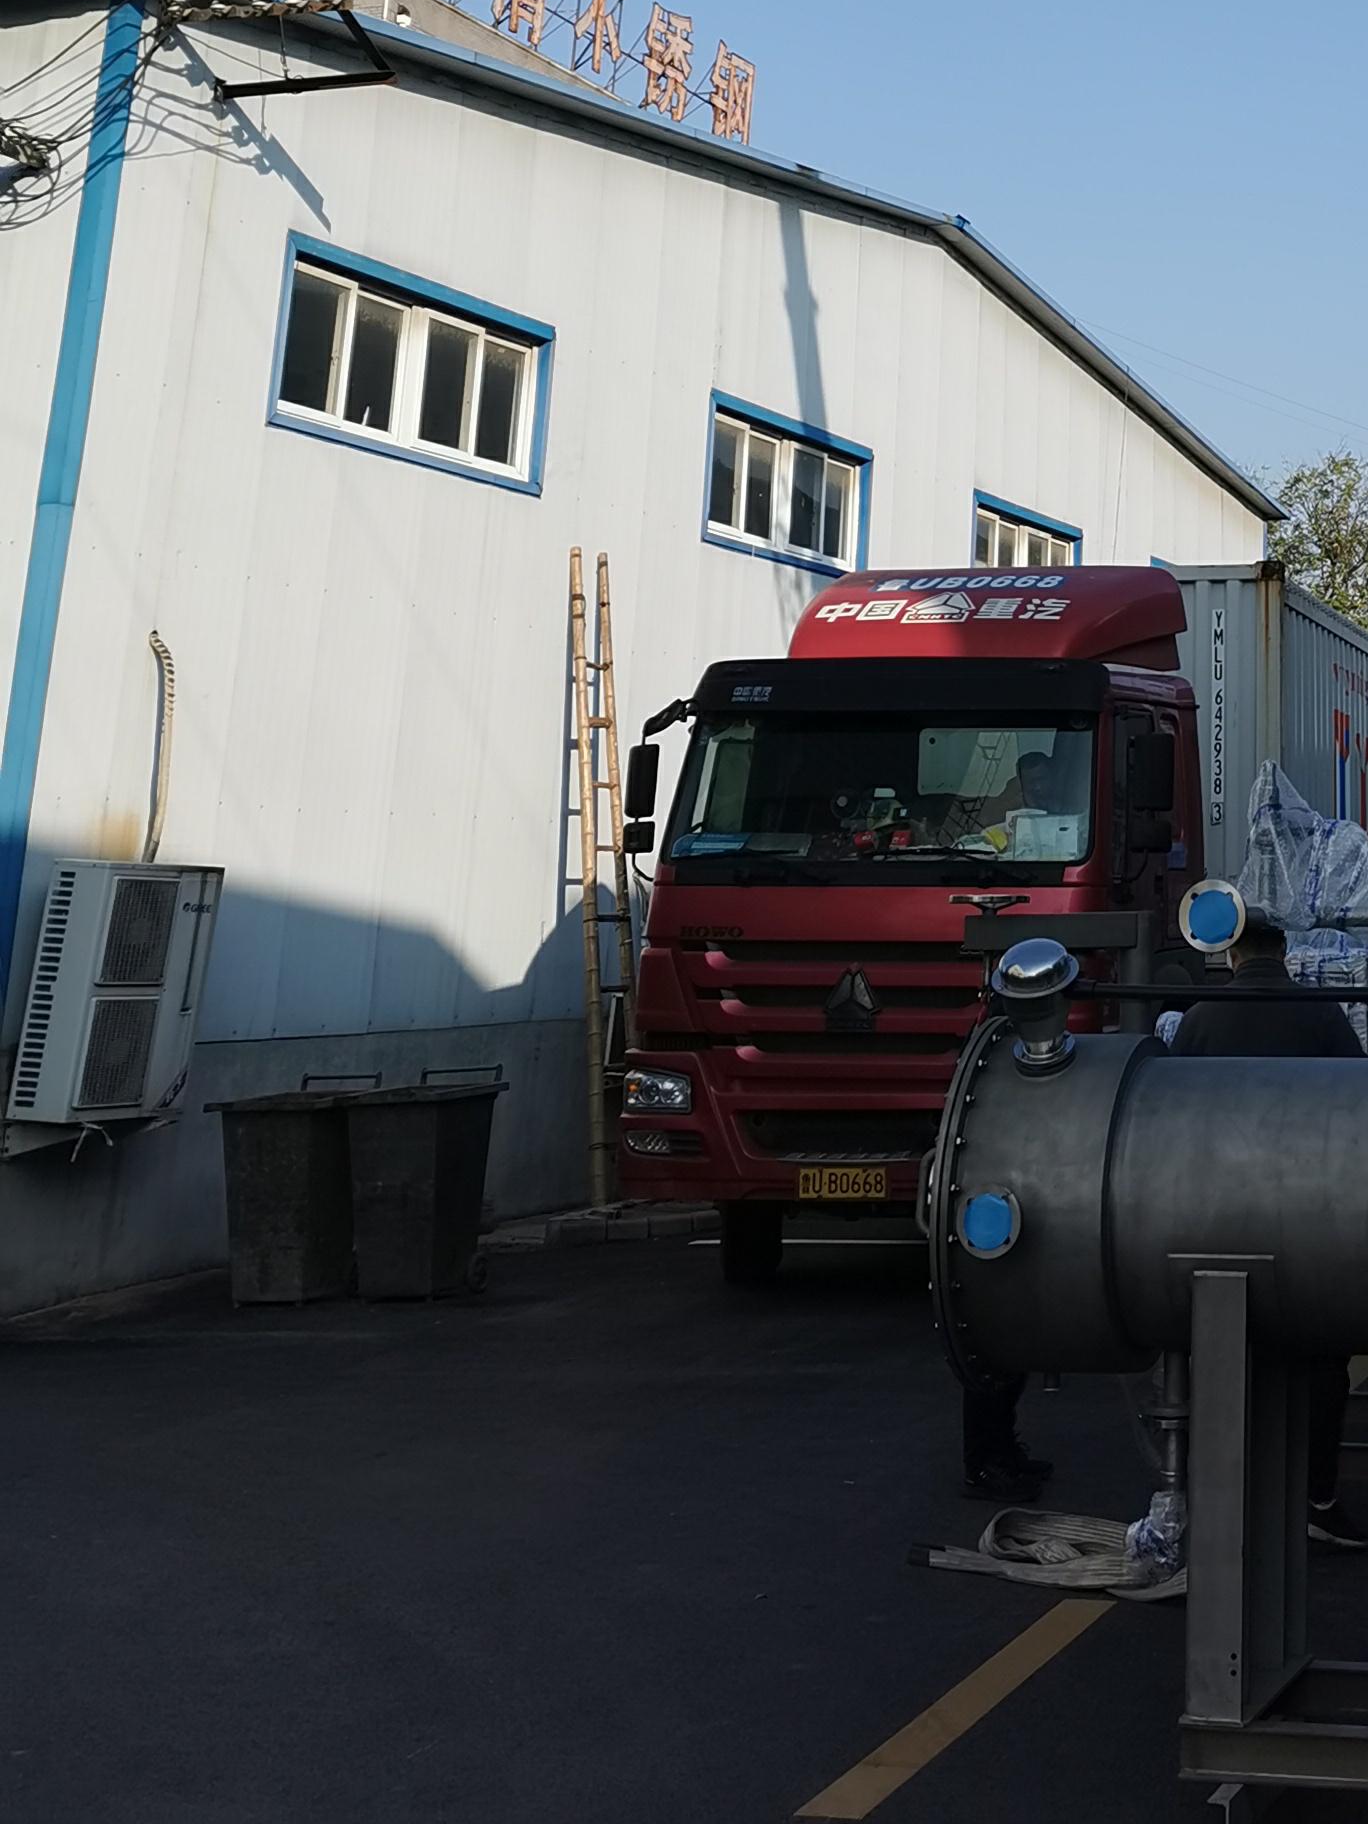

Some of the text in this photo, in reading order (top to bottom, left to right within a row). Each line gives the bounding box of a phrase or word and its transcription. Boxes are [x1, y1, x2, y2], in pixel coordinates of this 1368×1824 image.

[815, 599, 909, 622] 中国
[973, 598, 1071, 620] 重汽
[1213, 611, 1224, 680] YMLU
[1213, 689, 1224, 794] 642938
